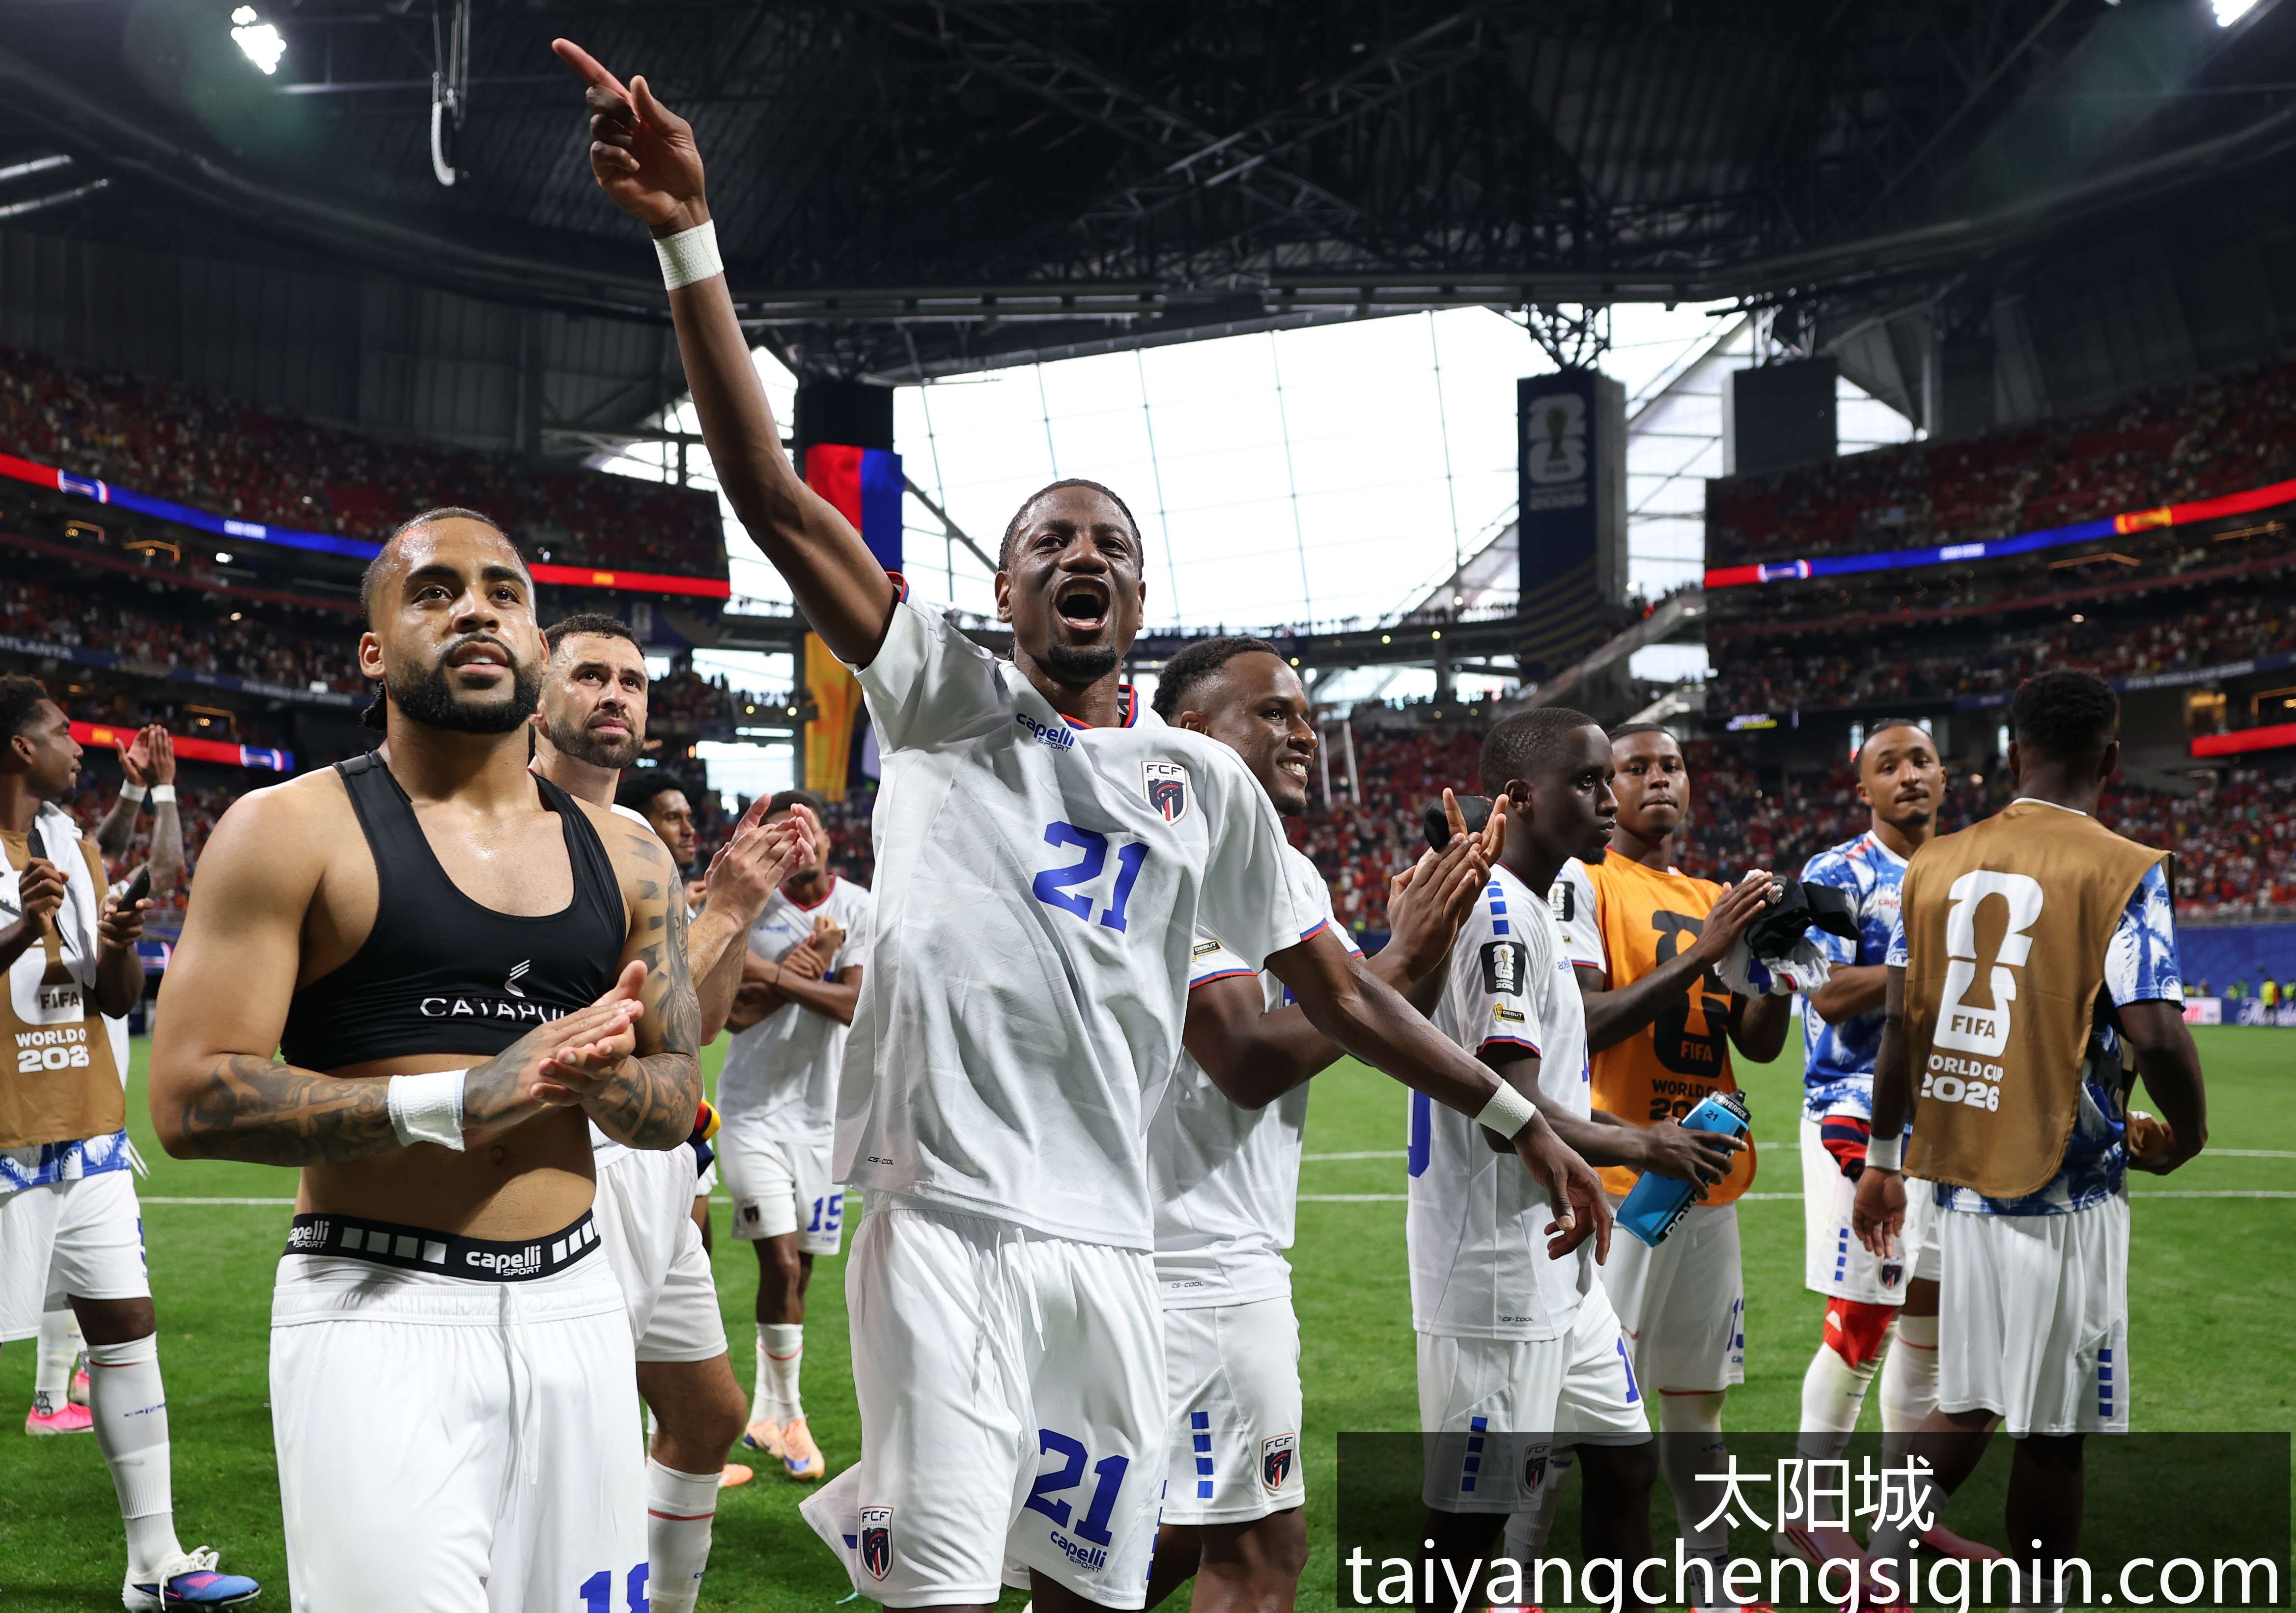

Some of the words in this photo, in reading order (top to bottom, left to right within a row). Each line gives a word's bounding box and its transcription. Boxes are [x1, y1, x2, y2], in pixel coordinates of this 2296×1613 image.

[1016, 713, 1075, 747] capelli
[1038, 737, 1071, 752] SPORT
[1147, 765, 1181, 775] FCF
[1032, 821, 1150, 934] 21
[1194, 943, 1216, 952] DEBUT
[40, 991, 80, 1009] FIFA
[420, 997, 565, 1023] CATAPU
[1951, 1015, 1996, 1038] FIFA
[15, 1028, 78, 1048] WORLD
[1680, 1040, 1713, 1062] FIFA
[1927, 1054, 1982, 1077] ORLD
[1983, 1064, 2004, 1083] CUP
[1652, 1079, 1704, 1097] WORLD
[1650, 1098, 1694, 1120] 20
[1705, 1110, 1719, 1121] 21
[1715, 1094, 1748, 1119] POWERADE
[807, 1194, 843, 1231] 15
[466, 1245, 541, 1274] capelli
[503, 1265, 541, 1276] SPORT
[1265, 1437, 1293, 1450] FCF
[1528, 1446, 1550, 1455] FCF
[1024, 1428, 1129, 1547] 21
[862, 1511, 889, 1523] FCF
[1050, 1531, 1107, 1568] capelli
[1069, 1556, 1101, 1573] SPORT
